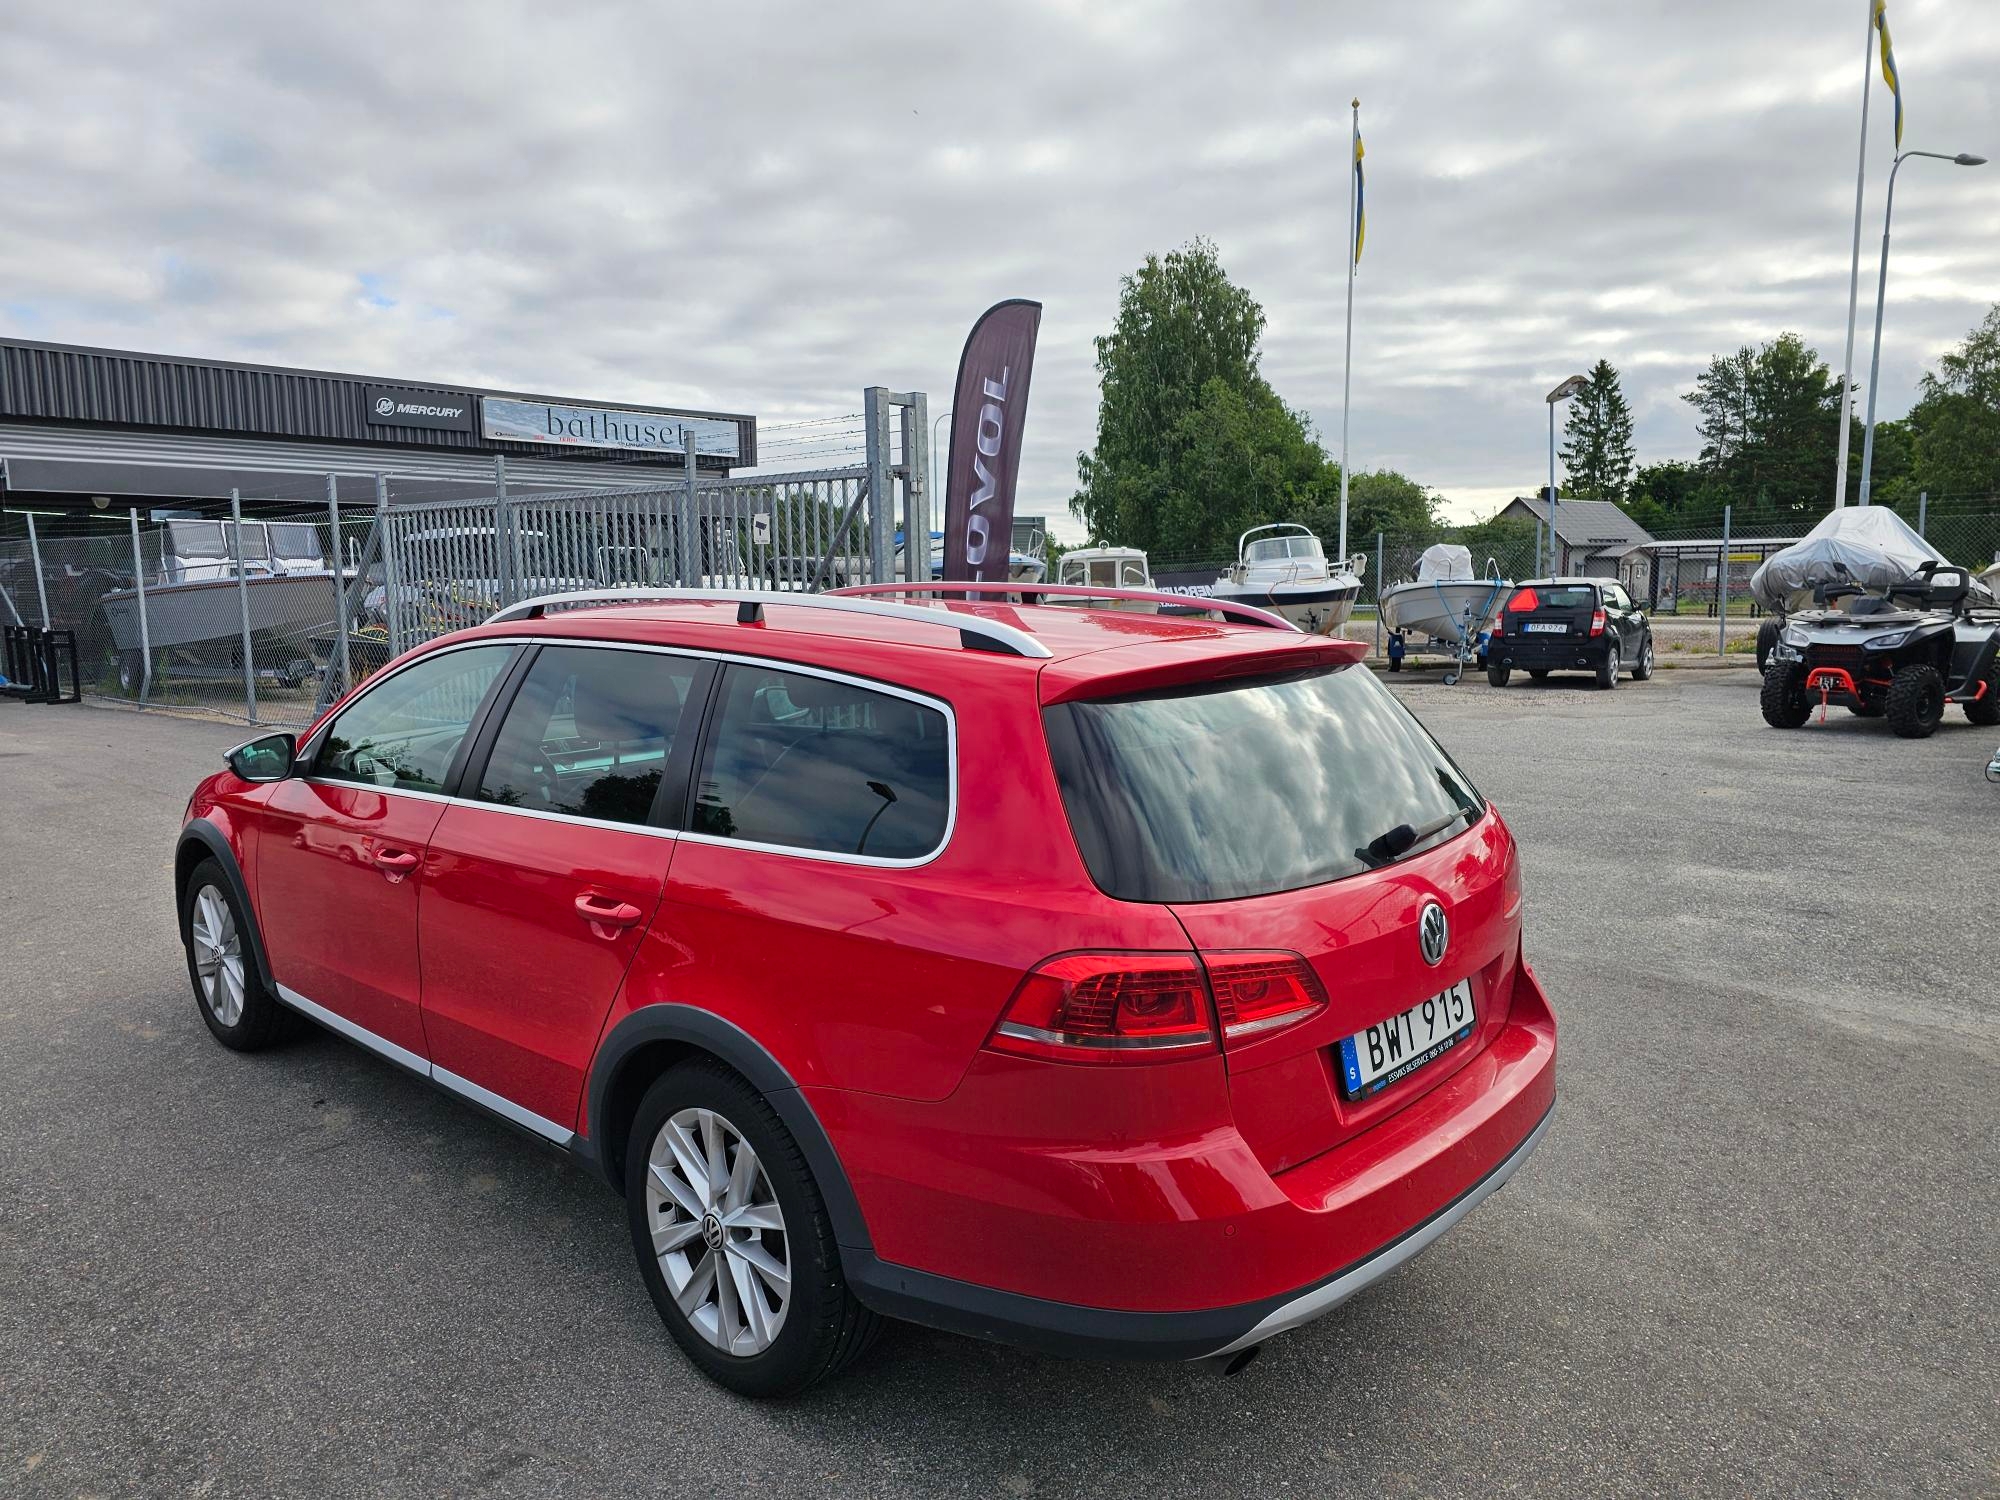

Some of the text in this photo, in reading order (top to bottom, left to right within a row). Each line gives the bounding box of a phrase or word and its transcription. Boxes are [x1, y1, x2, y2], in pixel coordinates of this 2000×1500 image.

[396, 403, 463, 418] MERCURY
[547, 407, 686, 446] båthuset
[1366, 984, 1464, 1073] BWT 915
[1349, 1067, 1356, 1079] S
